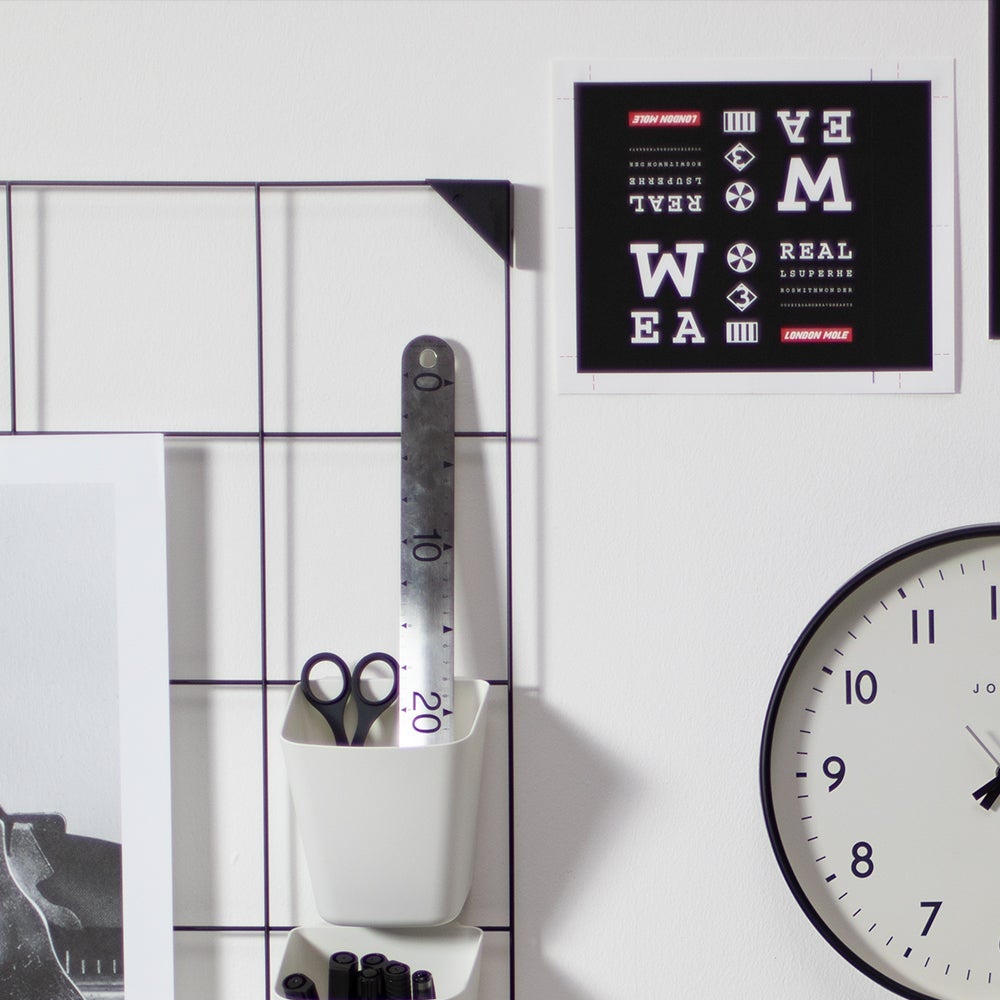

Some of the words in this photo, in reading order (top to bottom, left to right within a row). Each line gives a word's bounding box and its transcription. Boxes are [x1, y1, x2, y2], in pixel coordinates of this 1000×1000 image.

[632, 115, 659, 124] MOLE
[660, 115, 697, 124] LONDON
[629, 177, 702, 185] LSUPERHE
[629, 195, 702, 212] REAL
[780, 242, 853, 259] REAL
[630, 243, 704, 297] W
[734, 286, 750, 307] 3
[784, 331, 822, 340] LONDON
[823, 331, 849, 340] MOLE
[413, 372, 443, 392] 0
[412, 528, 443, 563] 10
[911, 609, 936, 644] 11
[844, 669, 878, 705] 10
[412, 691, 443, 734] 20
[822, 756, 846, 792] 9
[851, 841, 874, 878] 8
[920, 901, 943, 937] 7
